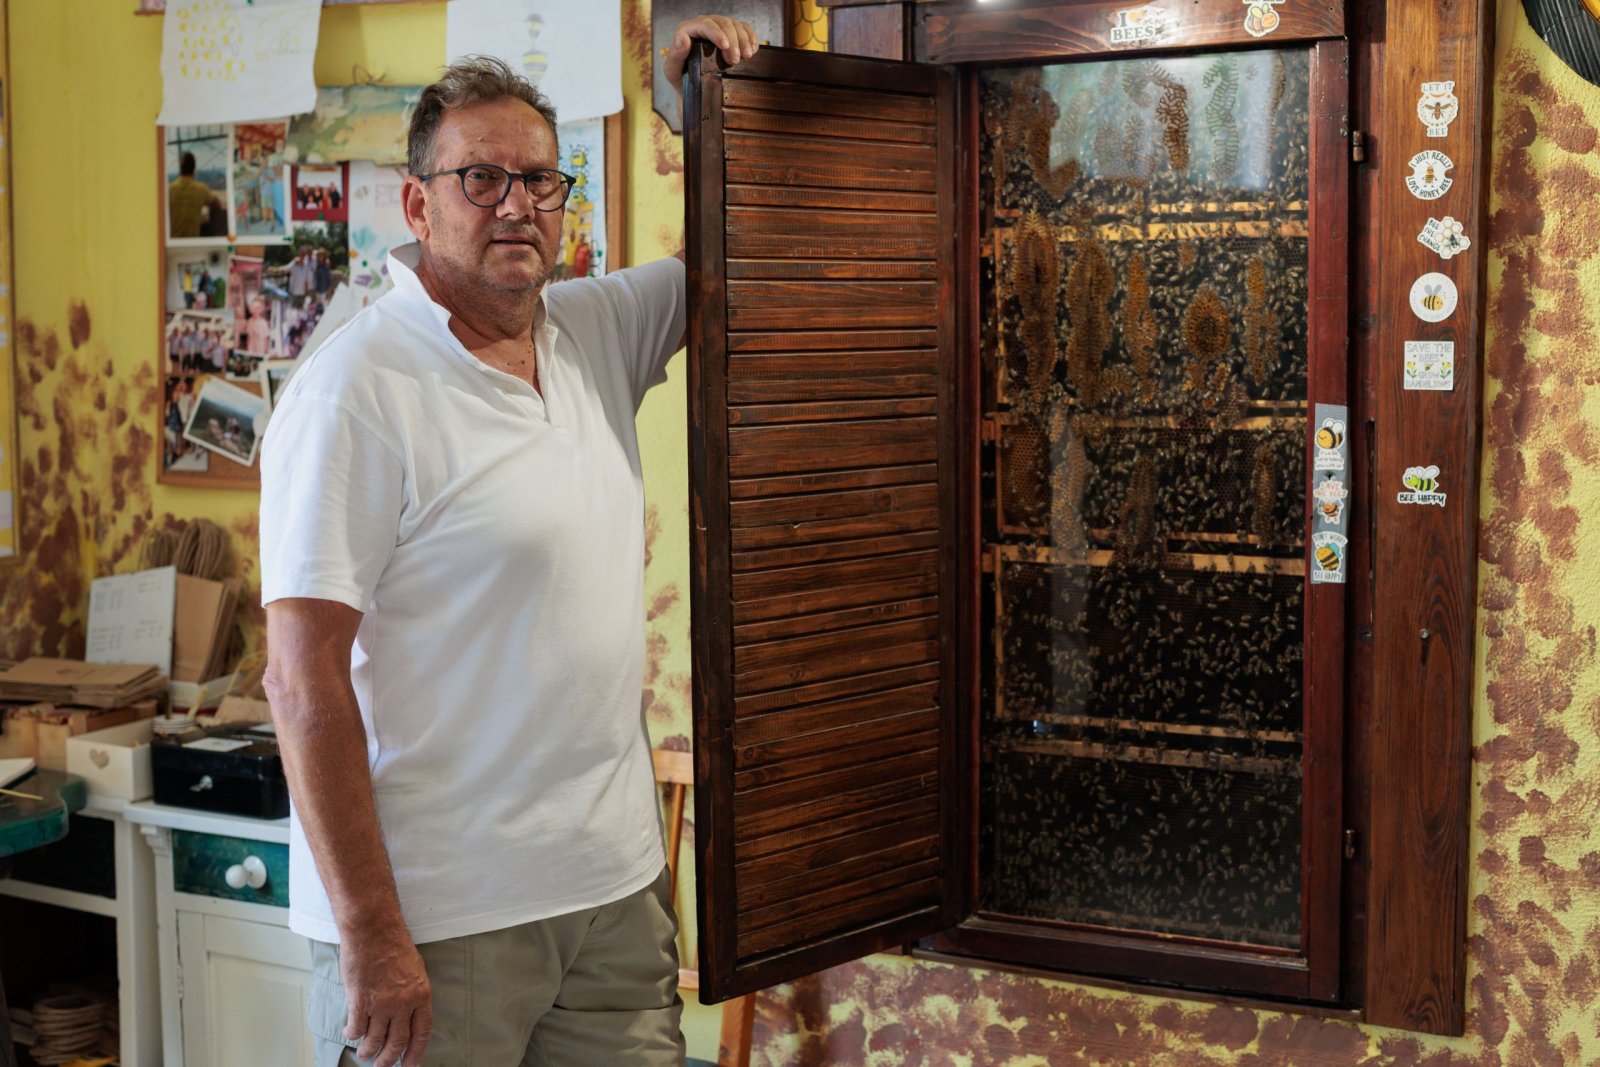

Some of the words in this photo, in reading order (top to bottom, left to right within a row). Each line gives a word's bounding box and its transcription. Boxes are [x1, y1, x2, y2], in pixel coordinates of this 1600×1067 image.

[1119, 12, 1127, 28] I
[1112, 25, 1154, 41] BEES
[1423, 83, 1441, 92] LET
[1444, 82, 1453, 91] IT
[1429, 128, 1447, 136] BEE
[1415, 152, 1429, 164] JUST
[1432, 152, 1452, 168] REALLY
[1408, 177, 1420, 193] LOVE
[1419, 188, 1440, 198] HONEY
[1440, 179, 1451, 191] BEE
[1428, 219, 1440, 230] BEE
[1424, 227, 1434, 237] THE
[1418, 234, 1440, 251] CHANGE
[1406, 343, 1430, 353] SAVE
[1433, 343, 1452, 353] THE
[1418, 353, 1440, 362] BEES
[1399, 494, 1415, 502] BEE
[1417, 494, 1445, 505] HAPPY
[1330, 534, 1347, 544] WORRY
[1314, 571, 1323, 579] BEE
[1324, 572, 1341, 581] HAPPY
